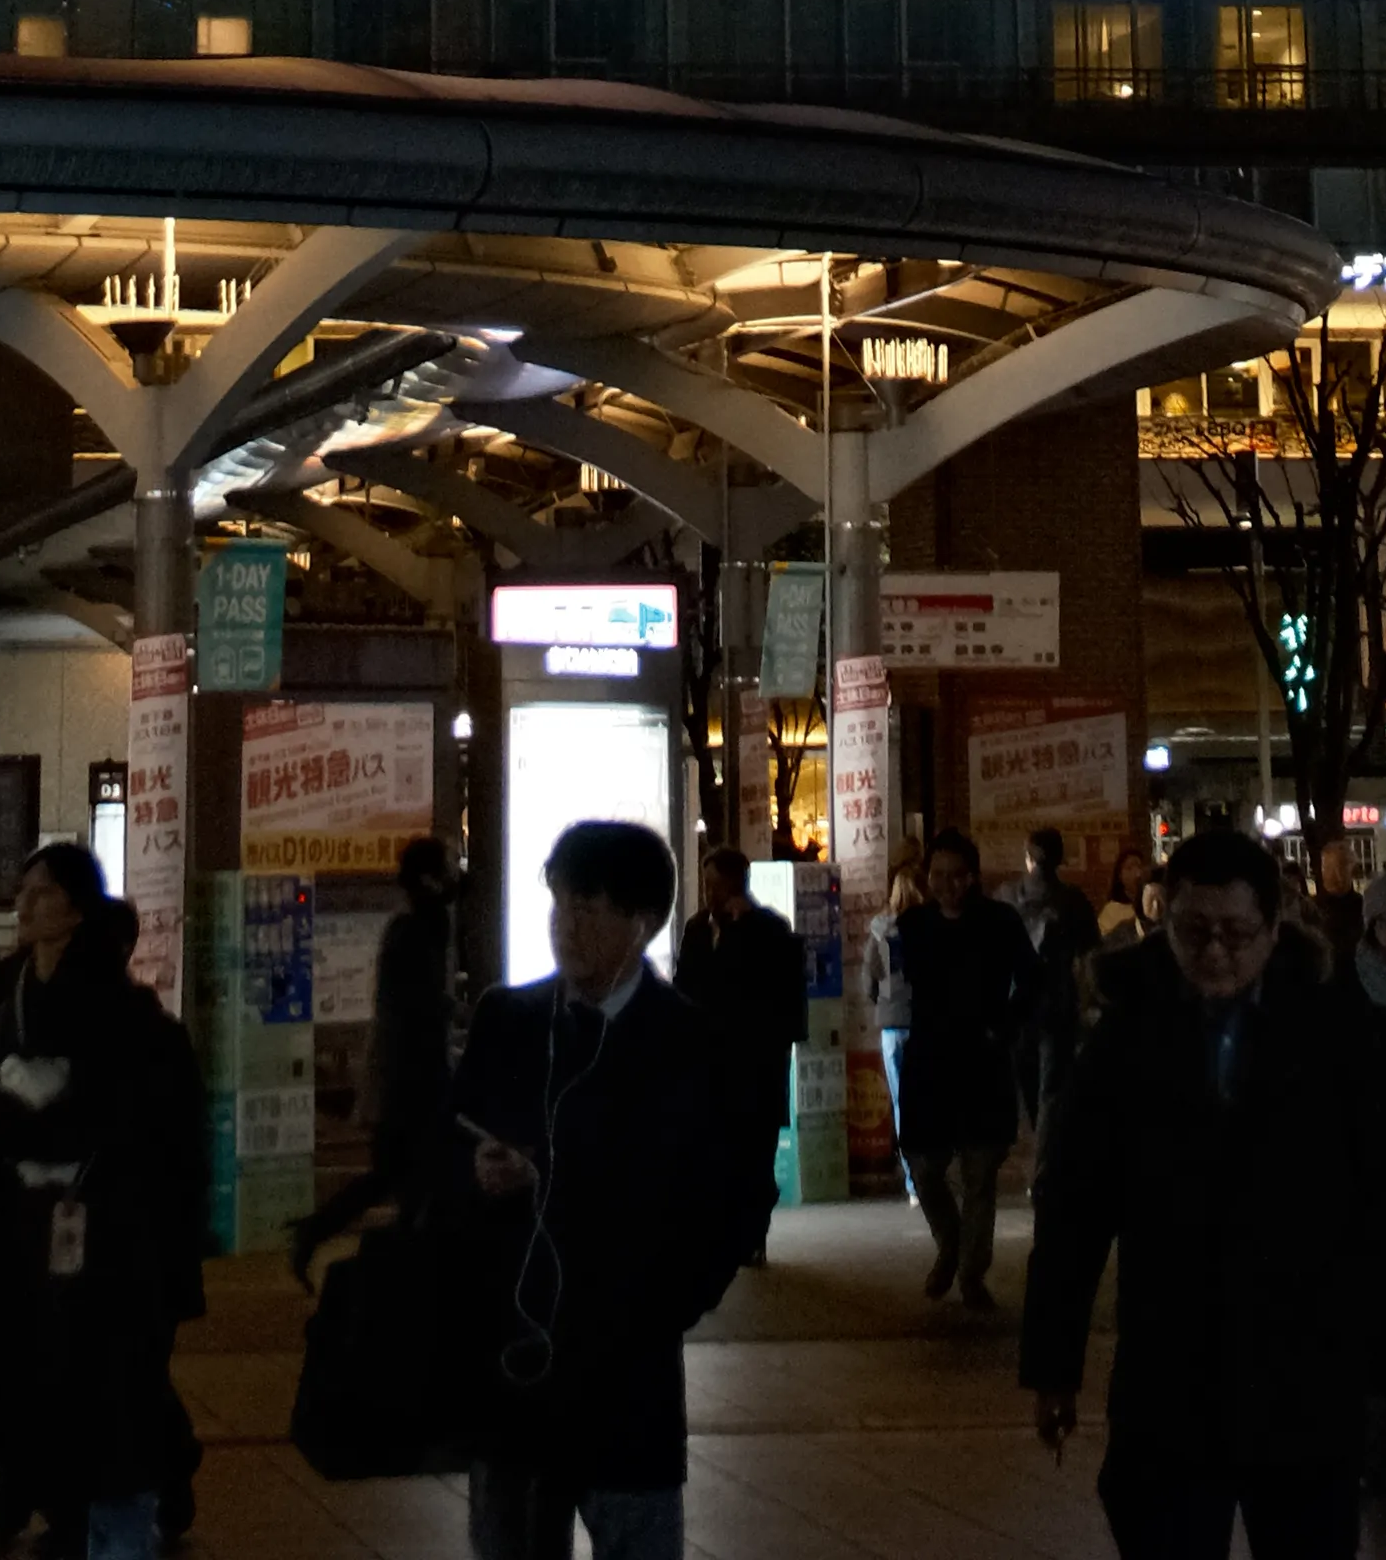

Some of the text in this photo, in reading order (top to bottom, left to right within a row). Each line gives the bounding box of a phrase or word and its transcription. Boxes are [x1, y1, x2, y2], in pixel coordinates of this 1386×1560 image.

[214, 595, 268, 624] PASS
[247, 747, 386, 810] 観光特急バス
[1343, 807, 1379, 823] orta
